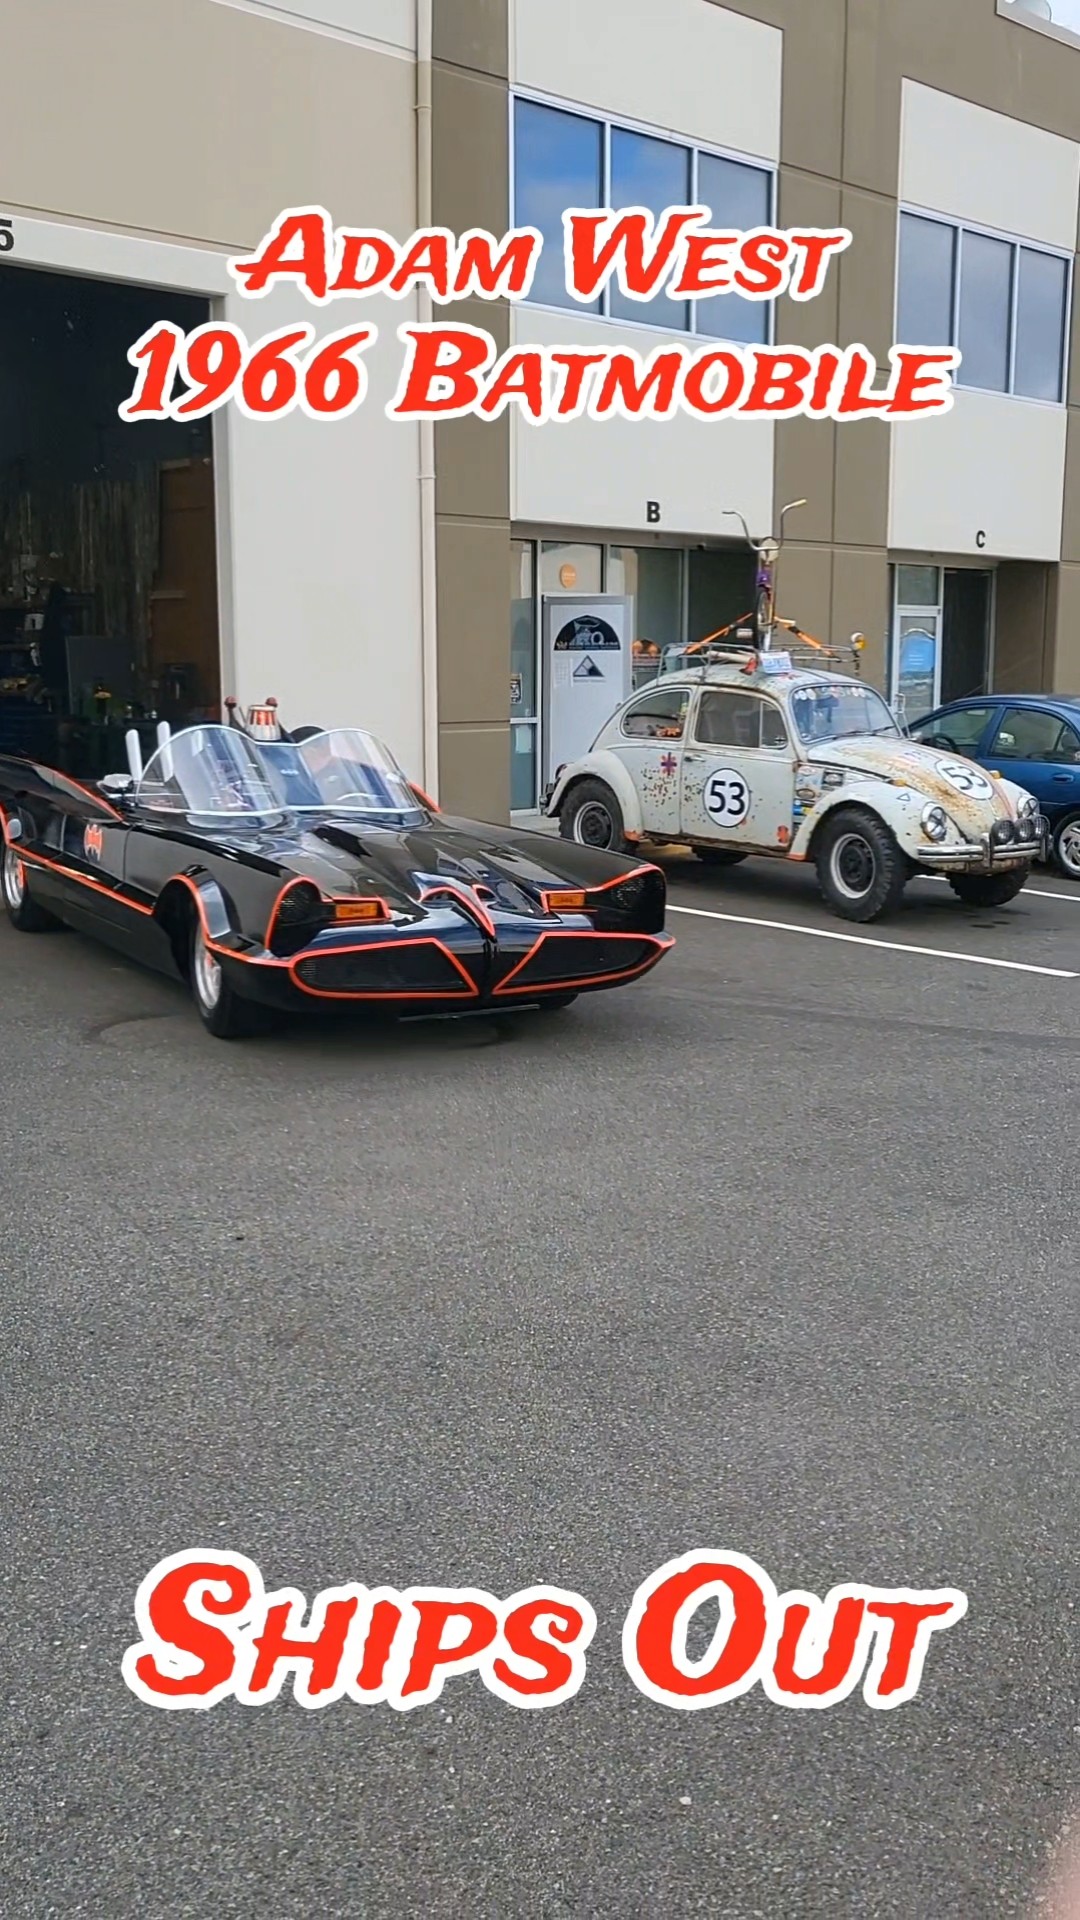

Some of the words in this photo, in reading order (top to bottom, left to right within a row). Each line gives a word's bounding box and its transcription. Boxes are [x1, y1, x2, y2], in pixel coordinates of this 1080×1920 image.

[646, 501, 661, 523] B
[975, 530, 987, 549] C
[941, 764, 989, 791] 53
[708, 779, 746, 816] 53
